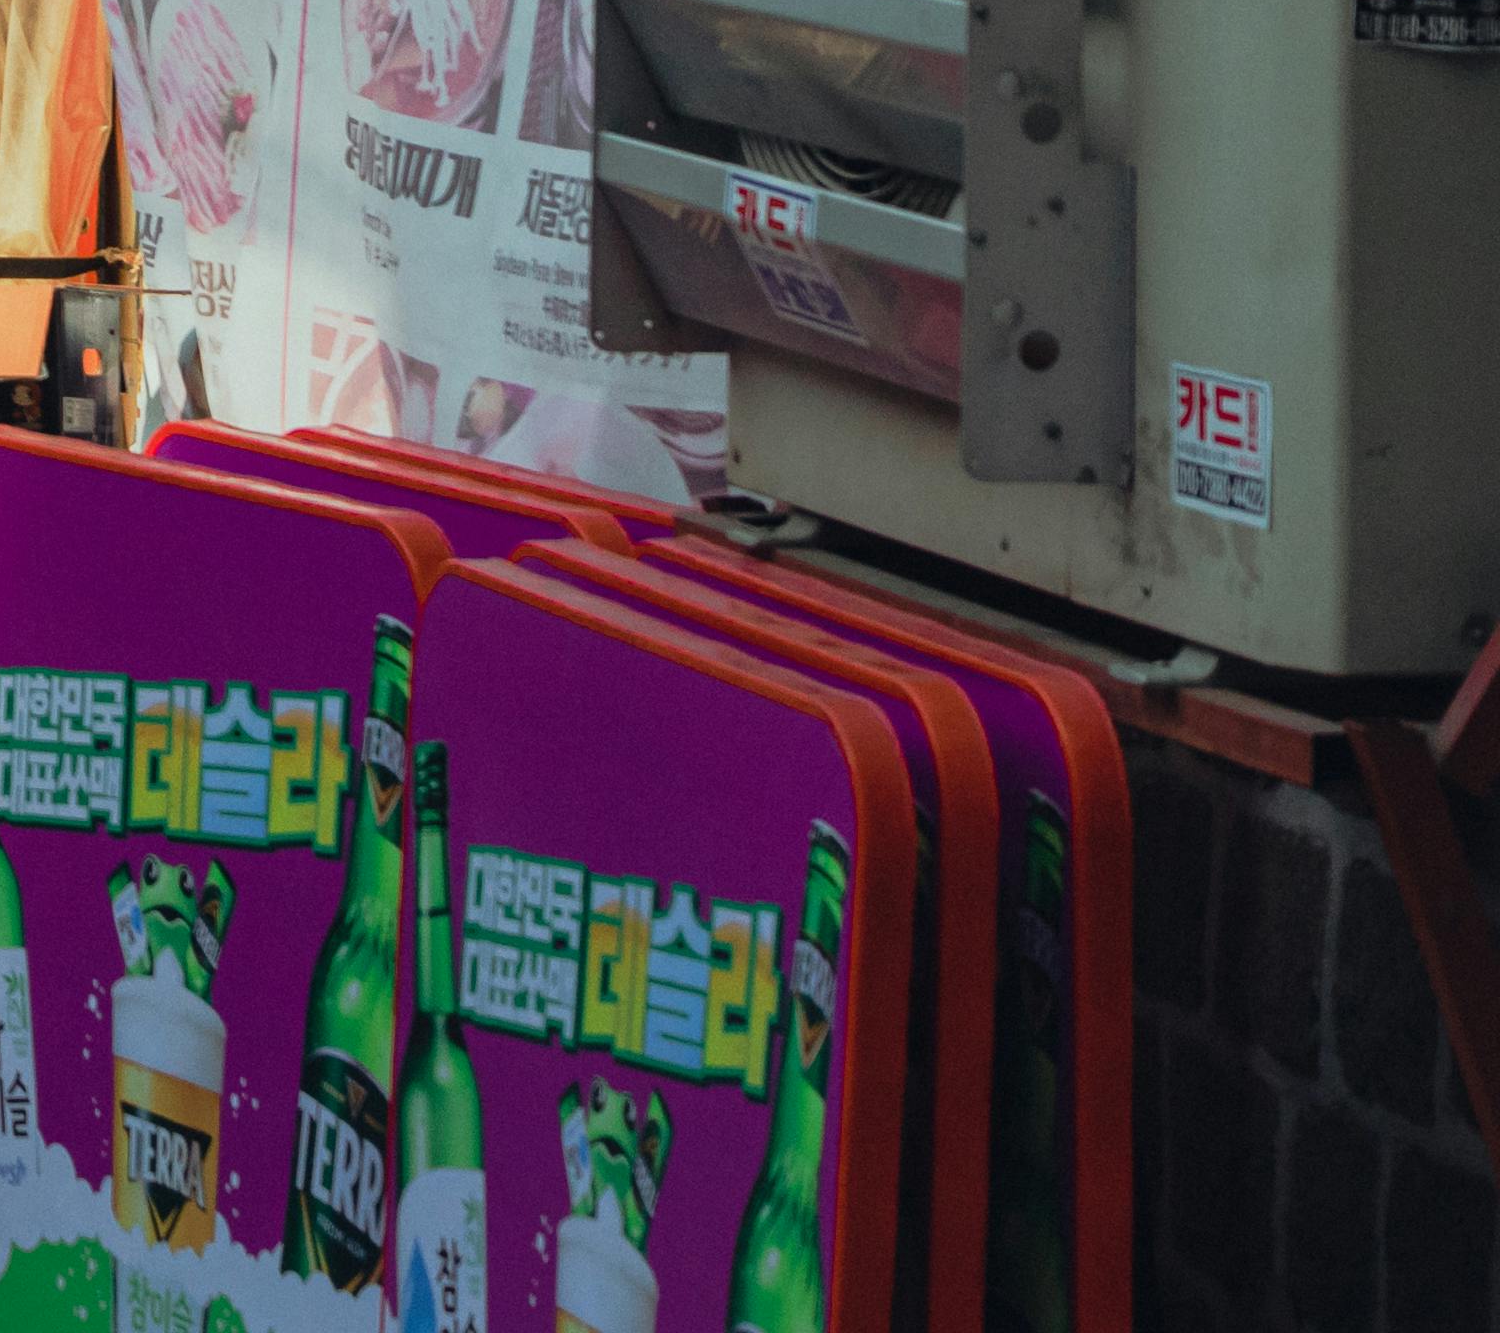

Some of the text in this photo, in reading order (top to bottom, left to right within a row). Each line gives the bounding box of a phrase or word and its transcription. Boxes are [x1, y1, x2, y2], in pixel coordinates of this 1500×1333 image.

[133, 682, 350, 848] 테슬라
[583, 880, 781, 1090] 테슬라
[121, 1114, 208, 1210] TERRA
[294, 1098, 388, 1251] TERR
